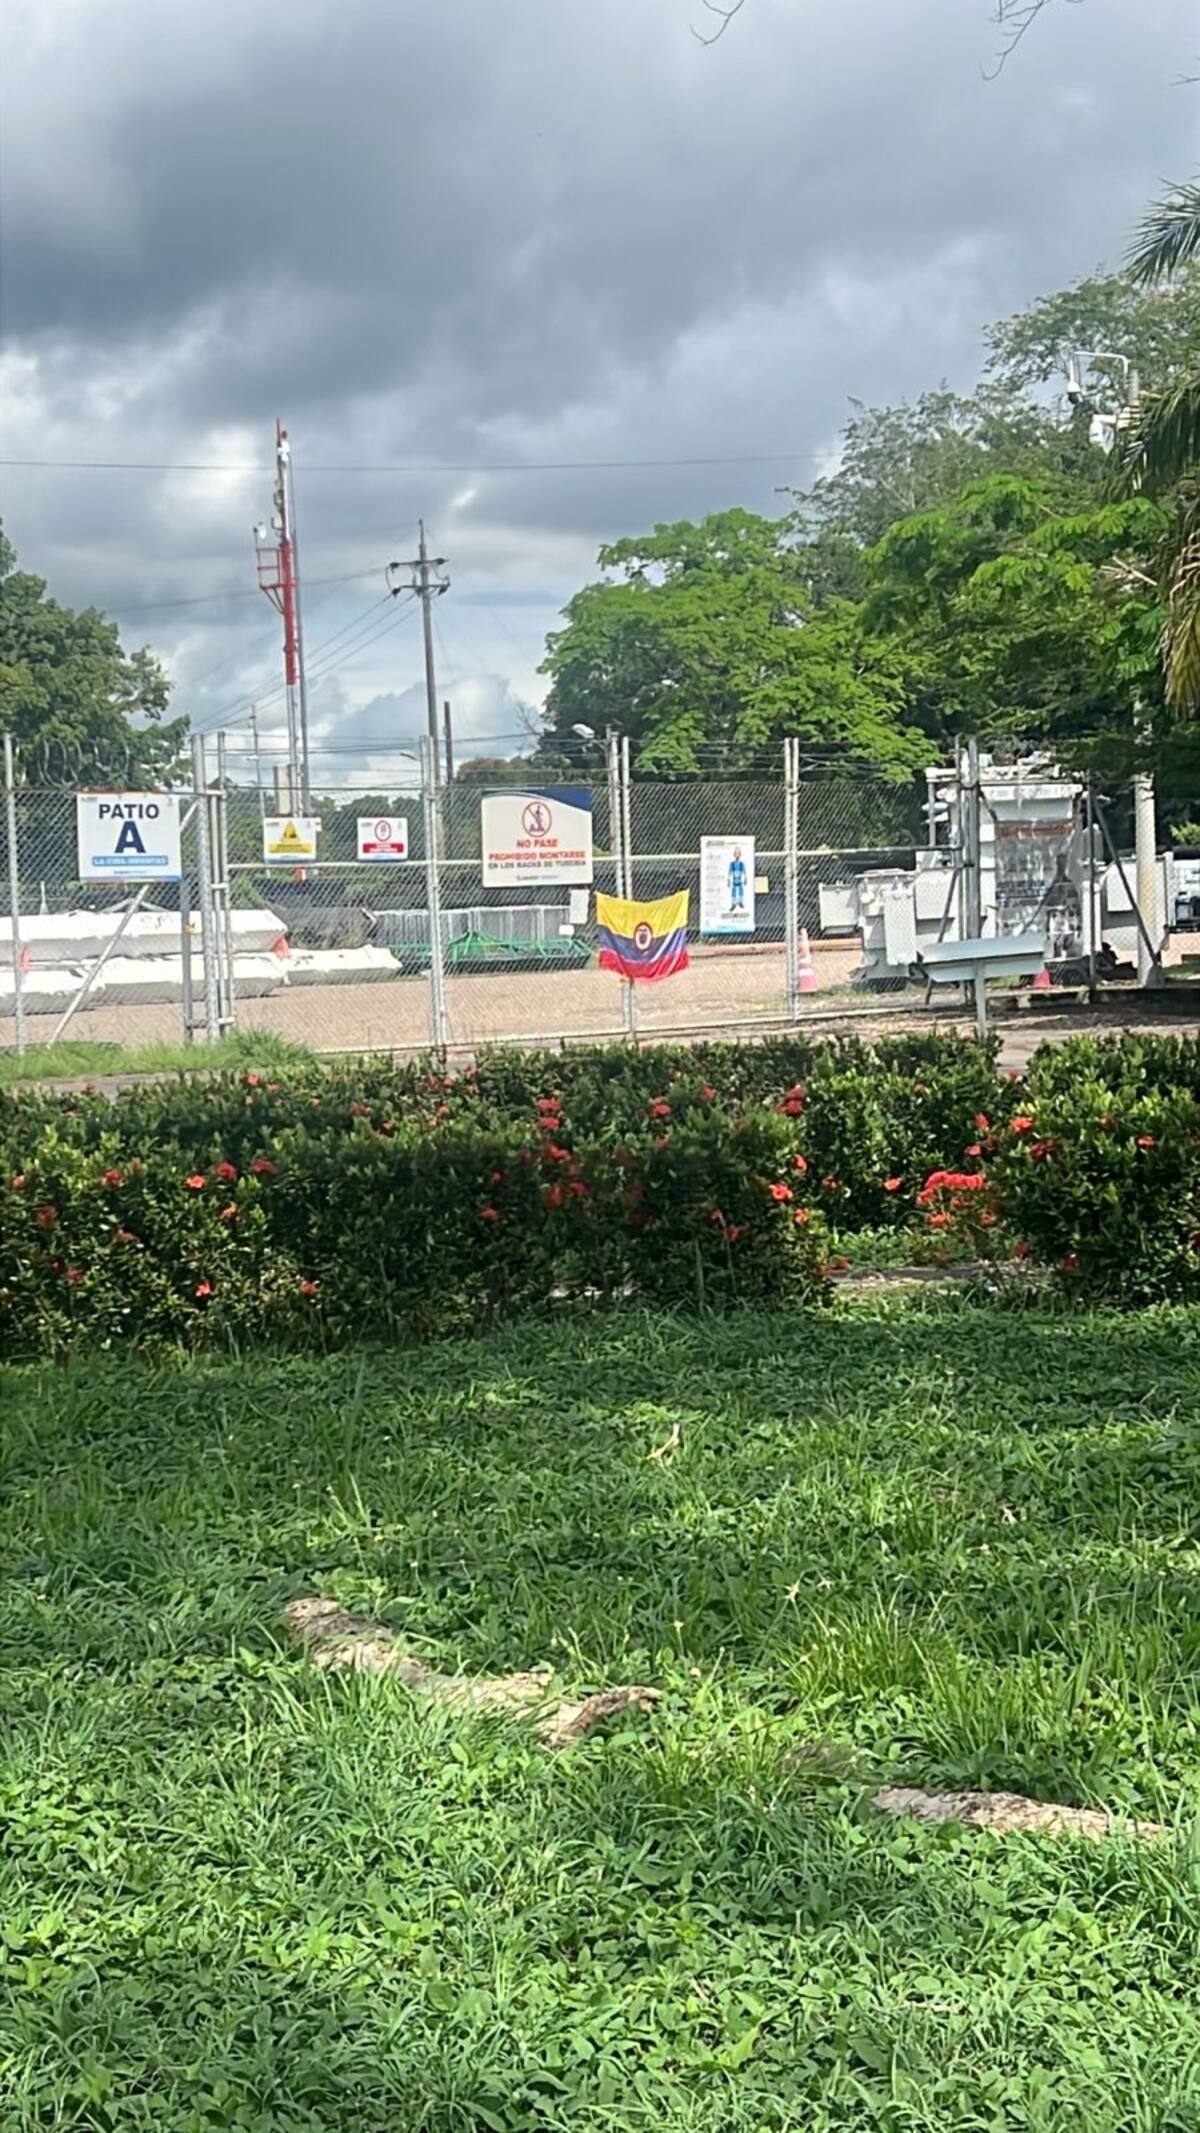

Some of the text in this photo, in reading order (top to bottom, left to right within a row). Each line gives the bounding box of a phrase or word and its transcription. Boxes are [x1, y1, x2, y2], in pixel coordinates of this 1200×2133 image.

[99, 804, 159, 819] PATIO
[114, 821, 146, 853] A
[517, 838, 559, 848] NO PASE
[489, 851, 586, 861] PROHIBIDO MONTARSE
